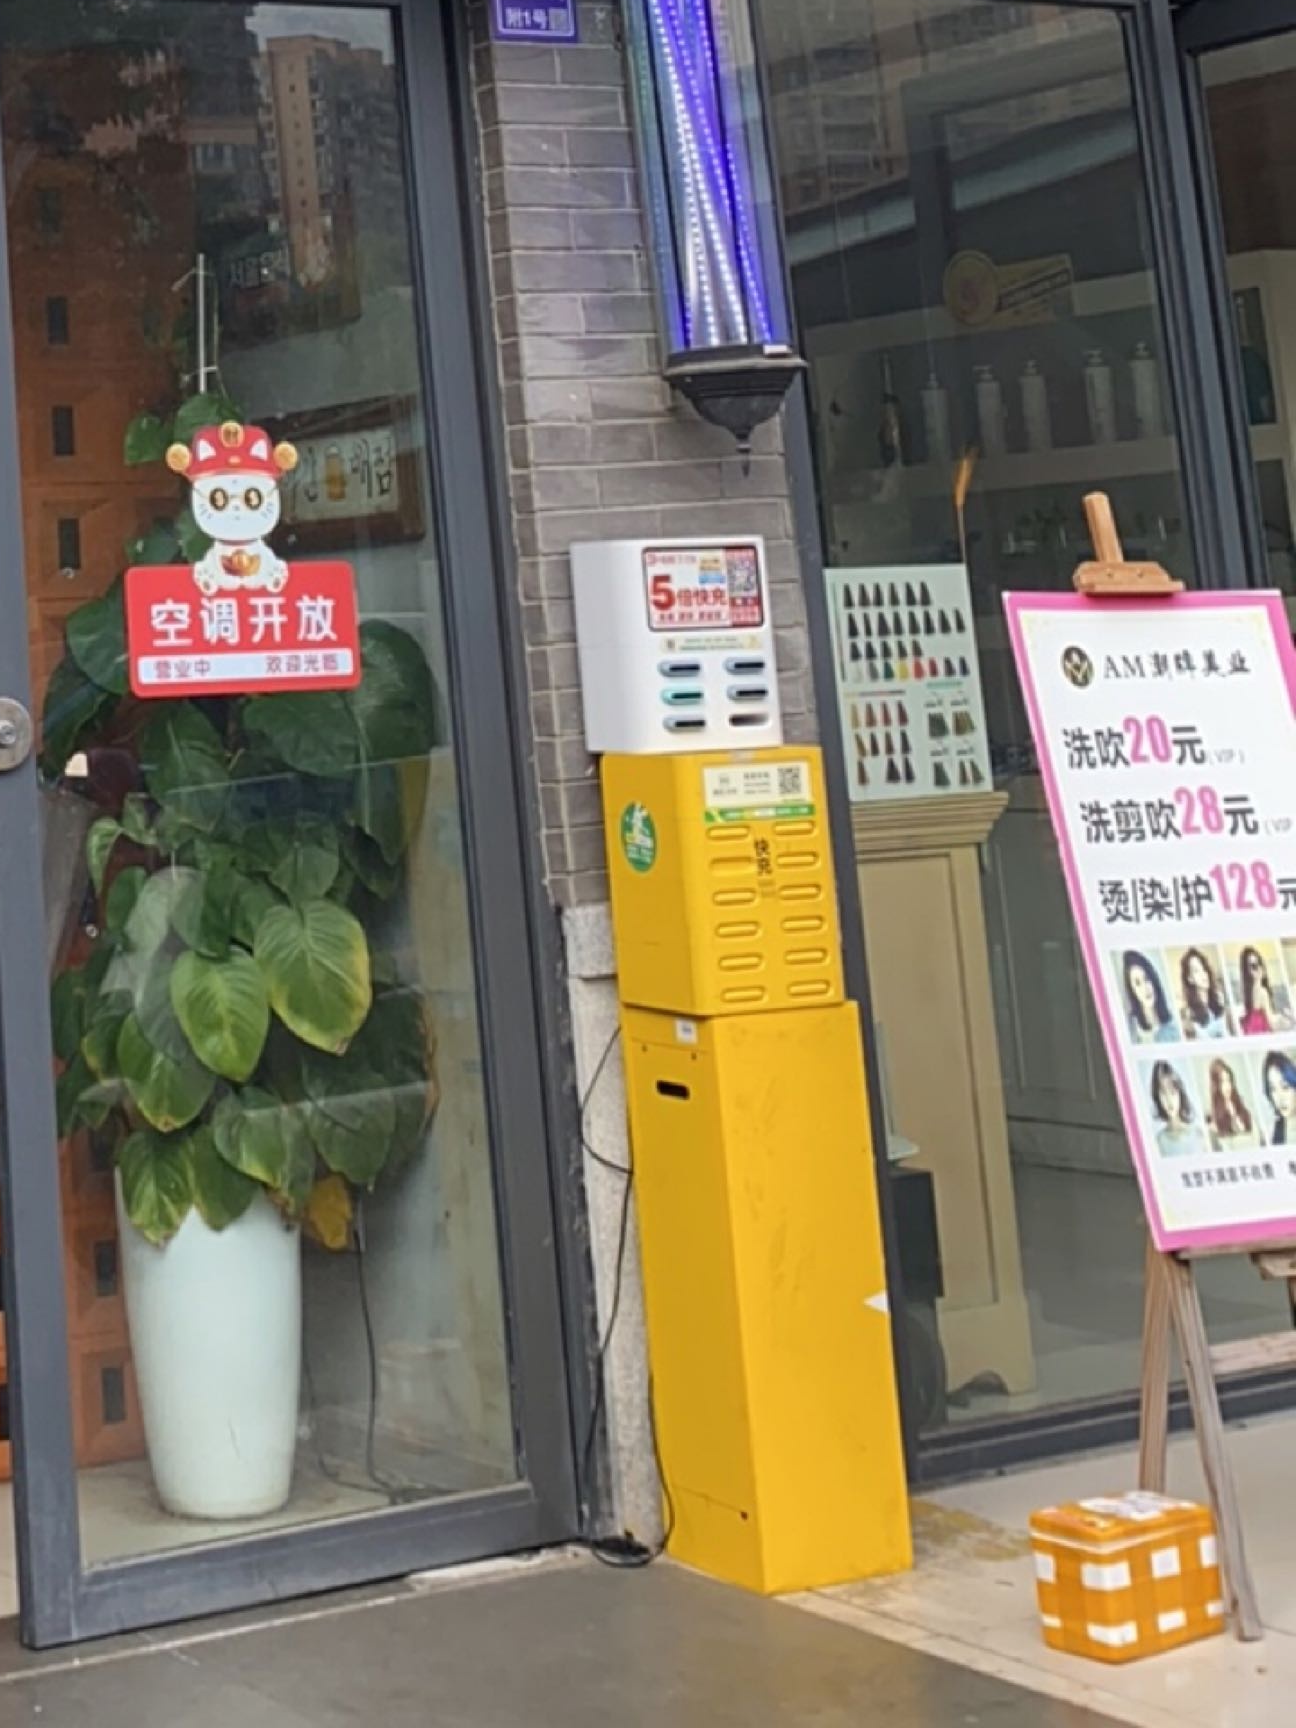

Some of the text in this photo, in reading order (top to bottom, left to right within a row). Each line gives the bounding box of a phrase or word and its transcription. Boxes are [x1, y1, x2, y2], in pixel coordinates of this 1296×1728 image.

[149, 595, 338, 648] 空调开放
[1061, 714, 1207, 770] 洗吹20元
[1079, 785, 1260, 844] 洗剪吹28元
